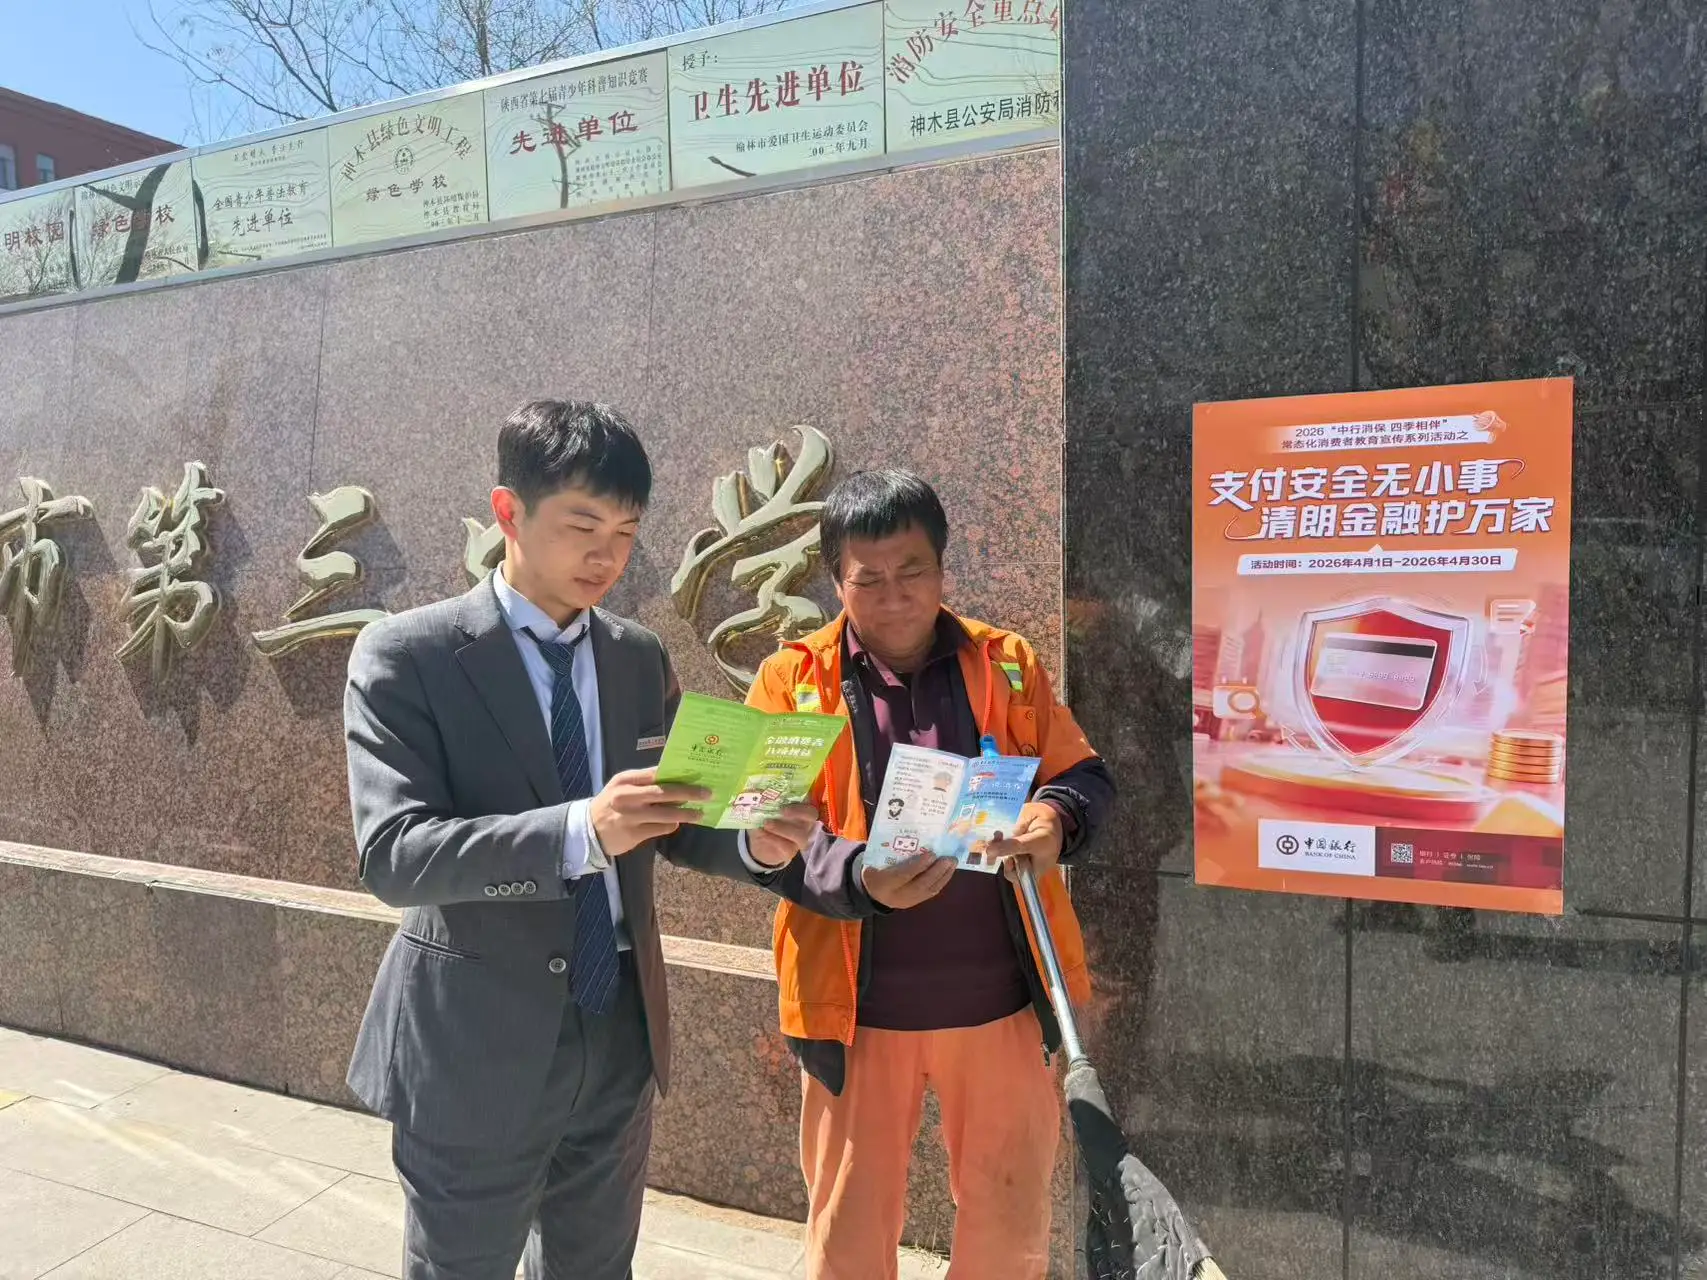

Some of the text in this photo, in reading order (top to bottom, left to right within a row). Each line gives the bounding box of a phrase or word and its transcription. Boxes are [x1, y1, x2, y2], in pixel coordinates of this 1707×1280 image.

[688, 60, 865, 122] 卫生先进单位
[341, 113, 472, 181] 神木县绿色文明工程
[510, 110, 638, 155] 先进单位
[736, 119, 868, 152] 榆林市爱国卫生运动委员会
[366, 174, 447, 201] 绿色学校
[232, 207, 293, 236] 先进单位
[1281, 430, 1470, 449] 常态化消费者教育宣传系列活动之
[1295, 427, 1325, 438] 2026
[1207, 458, 1512, 512] 支付安全无小事
[1240, 496, 1556, 541] 清朗金融护万家
[1303, 837, 1357, 853] 中国银行
